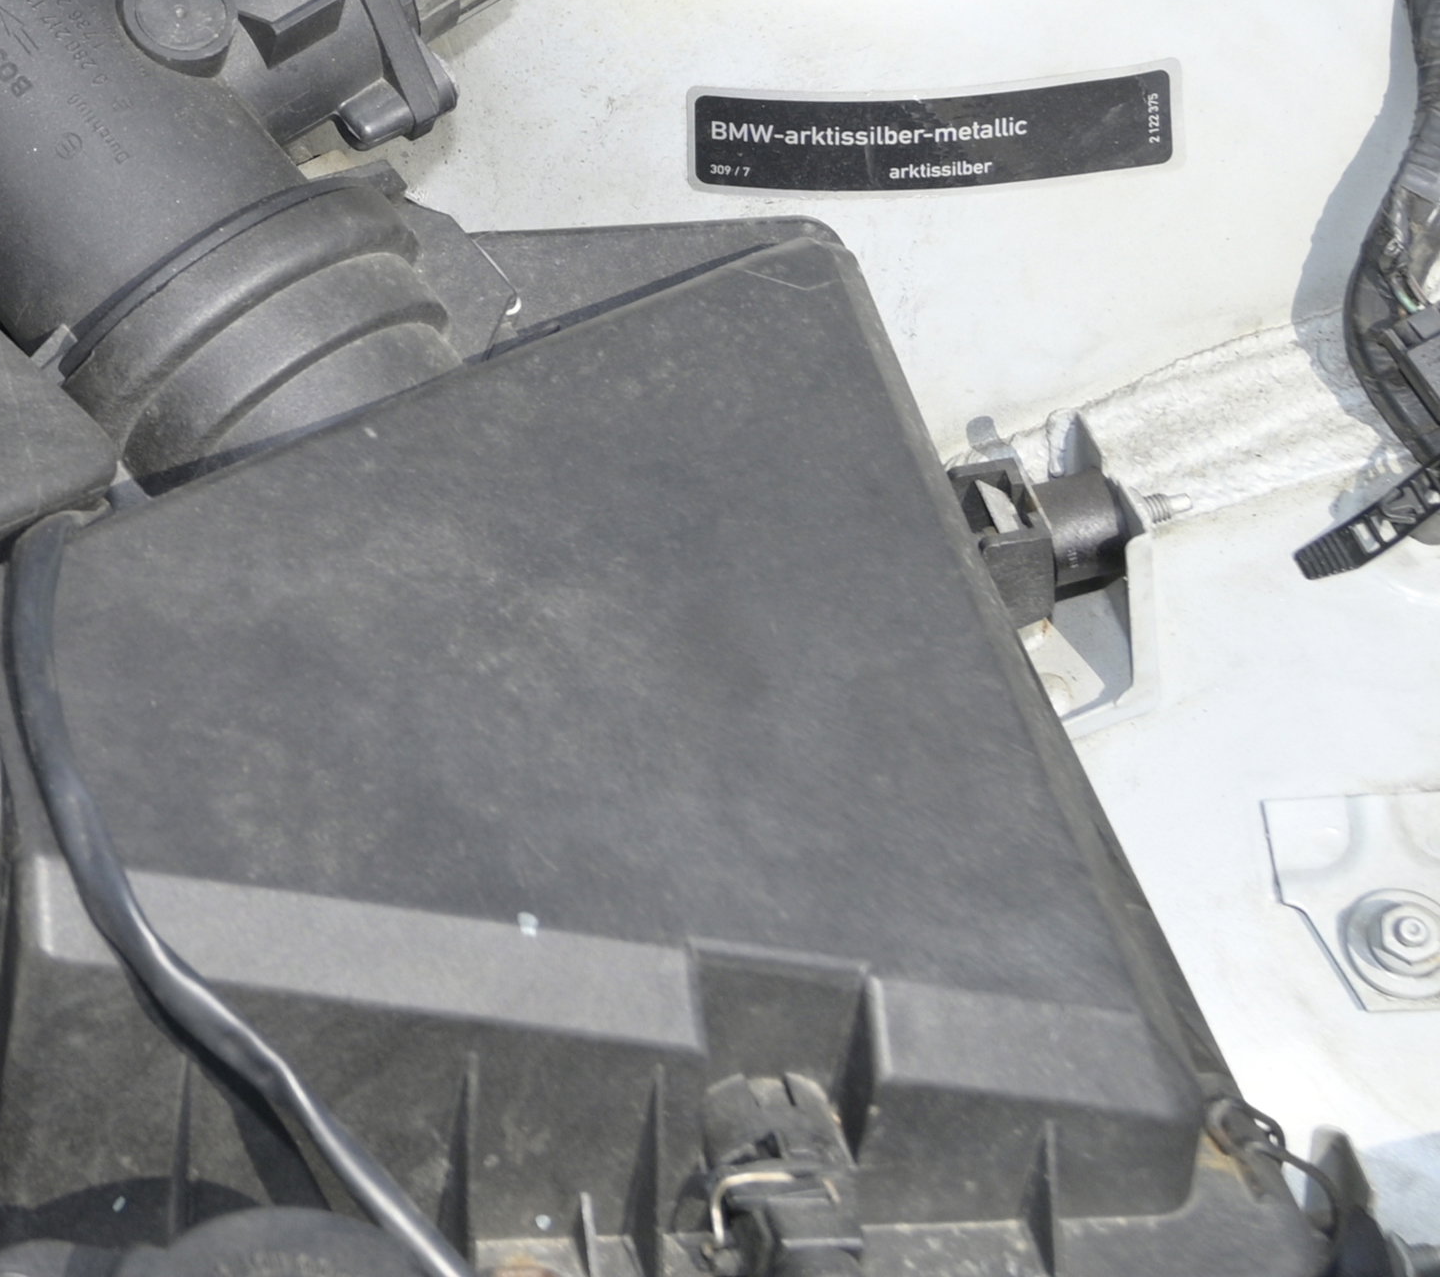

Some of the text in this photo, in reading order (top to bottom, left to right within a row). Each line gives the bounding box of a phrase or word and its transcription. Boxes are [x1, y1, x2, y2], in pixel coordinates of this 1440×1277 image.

[710, 116, 1028, 146] BMW-arktissilber-metallic
[1149, 92, 1160, 144] 2 122 375
[709, 164, 732, 177] 309
[743, 165, 751, 178] 7
[888, 159, 993, 181] arktissilber
